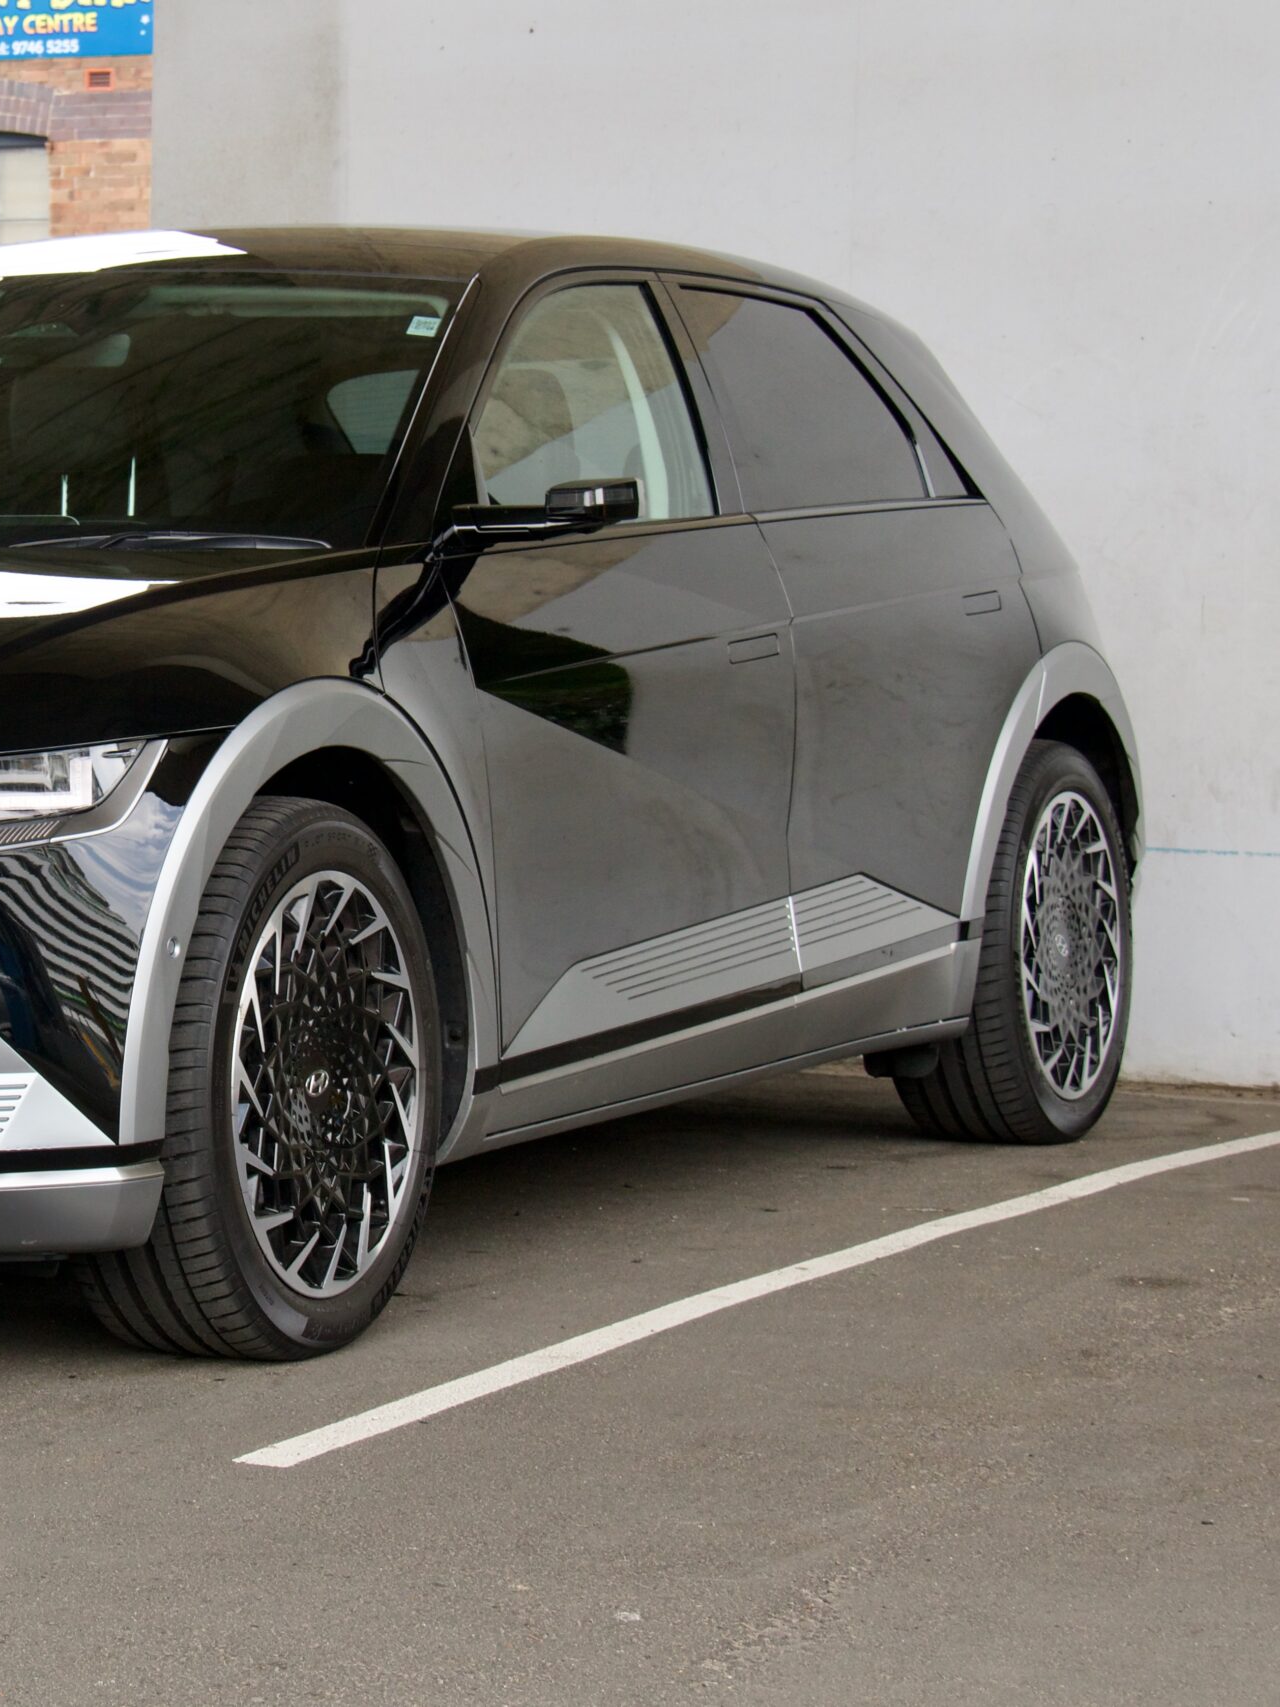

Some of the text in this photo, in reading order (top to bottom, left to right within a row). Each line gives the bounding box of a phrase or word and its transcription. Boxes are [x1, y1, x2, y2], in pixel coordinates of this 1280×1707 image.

[22, 11, 98, 35] CENTRE
[11, 39, 44, 55] 9746
[45, 38, 79, 54] 5255
[237, 843, 299, 957] MICHELIN
